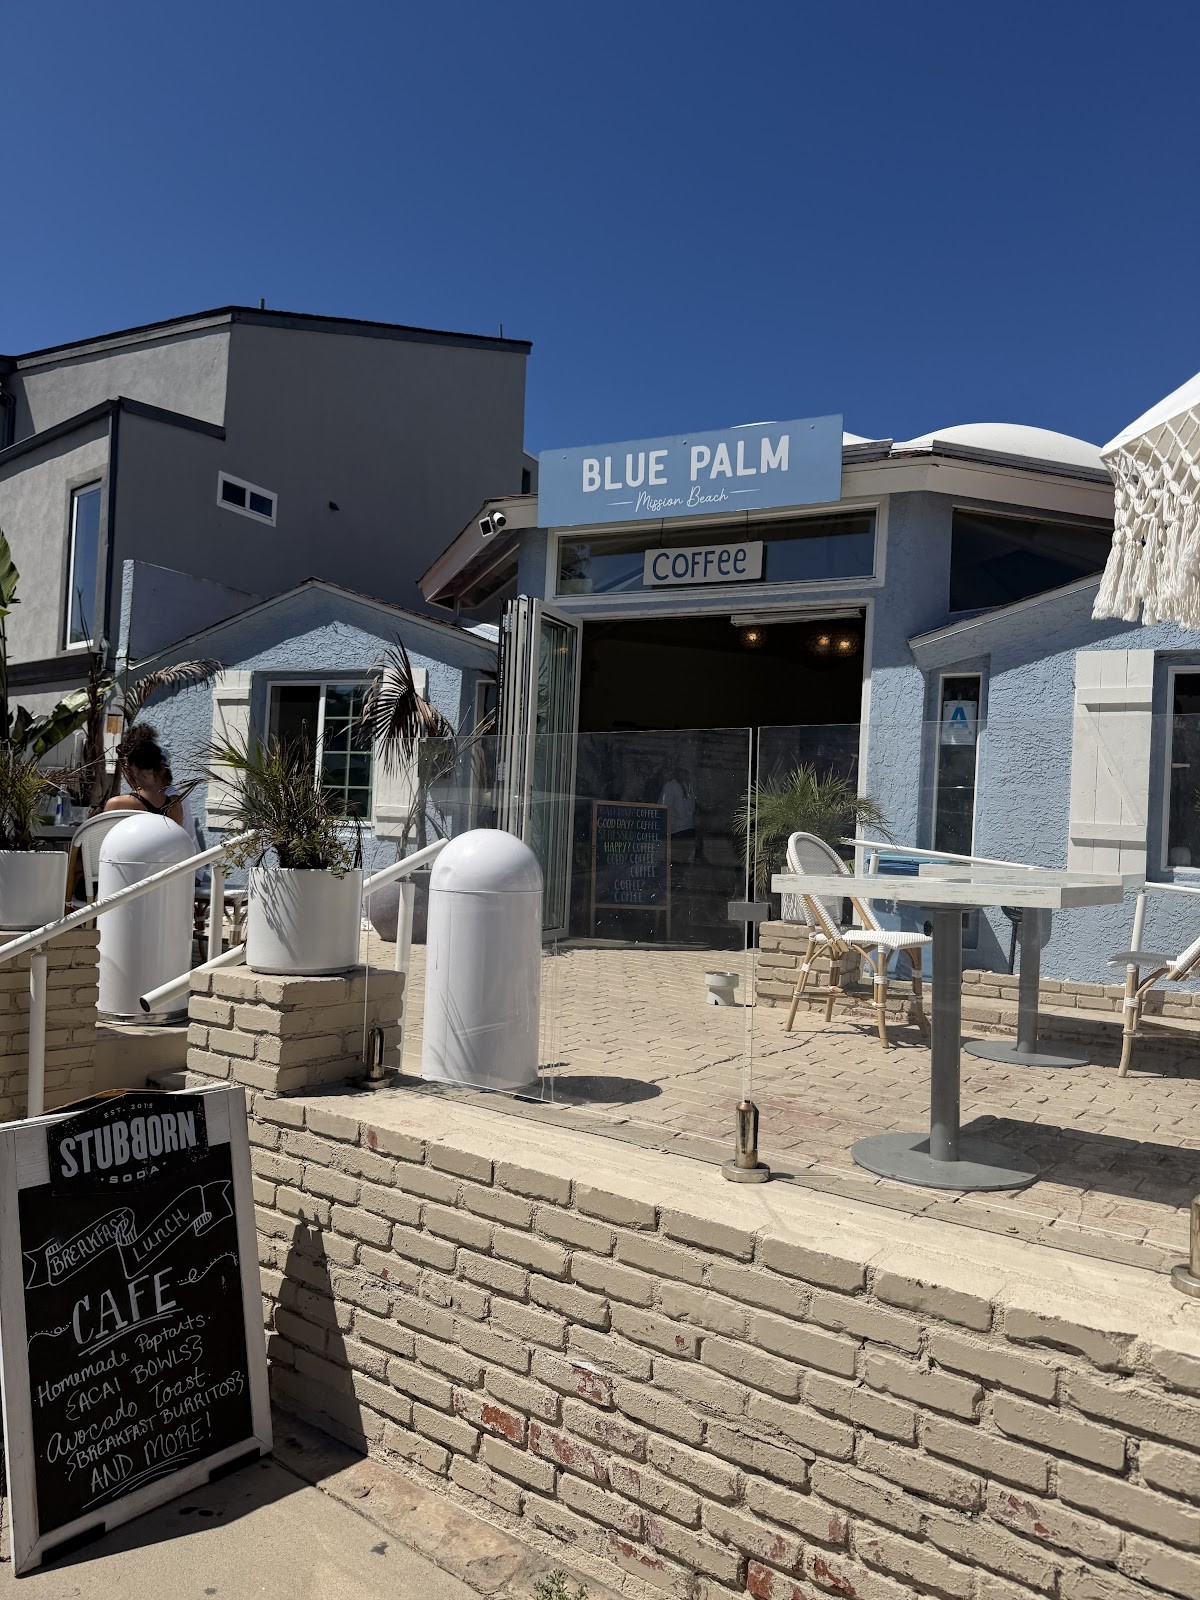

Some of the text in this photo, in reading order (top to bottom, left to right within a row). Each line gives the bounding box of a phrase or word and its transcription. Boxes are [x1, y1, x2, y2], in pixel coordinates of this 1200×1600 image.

[582, 434, 790, 493] BLUE PALM
[634, 485, 729, 513] Mission Beach
[948, 706, 969, 728] A
[597, 818, 616, 829] GOOD
[604, 841, 631, 853] HAPPY?
[103, 1102, 153, 1119] EST. 2015
[59, 1110, 197, 1178] STUBBORN
[109, 1165, 159, 1184] SODA
[50, 1208, 128, 1276] BREAKFAST
[72, 1266, 177, 1345] CAFE
[37, 1350, 130, 1407] Homemade
[91, 1411, 212, 1493] AND MORE!
